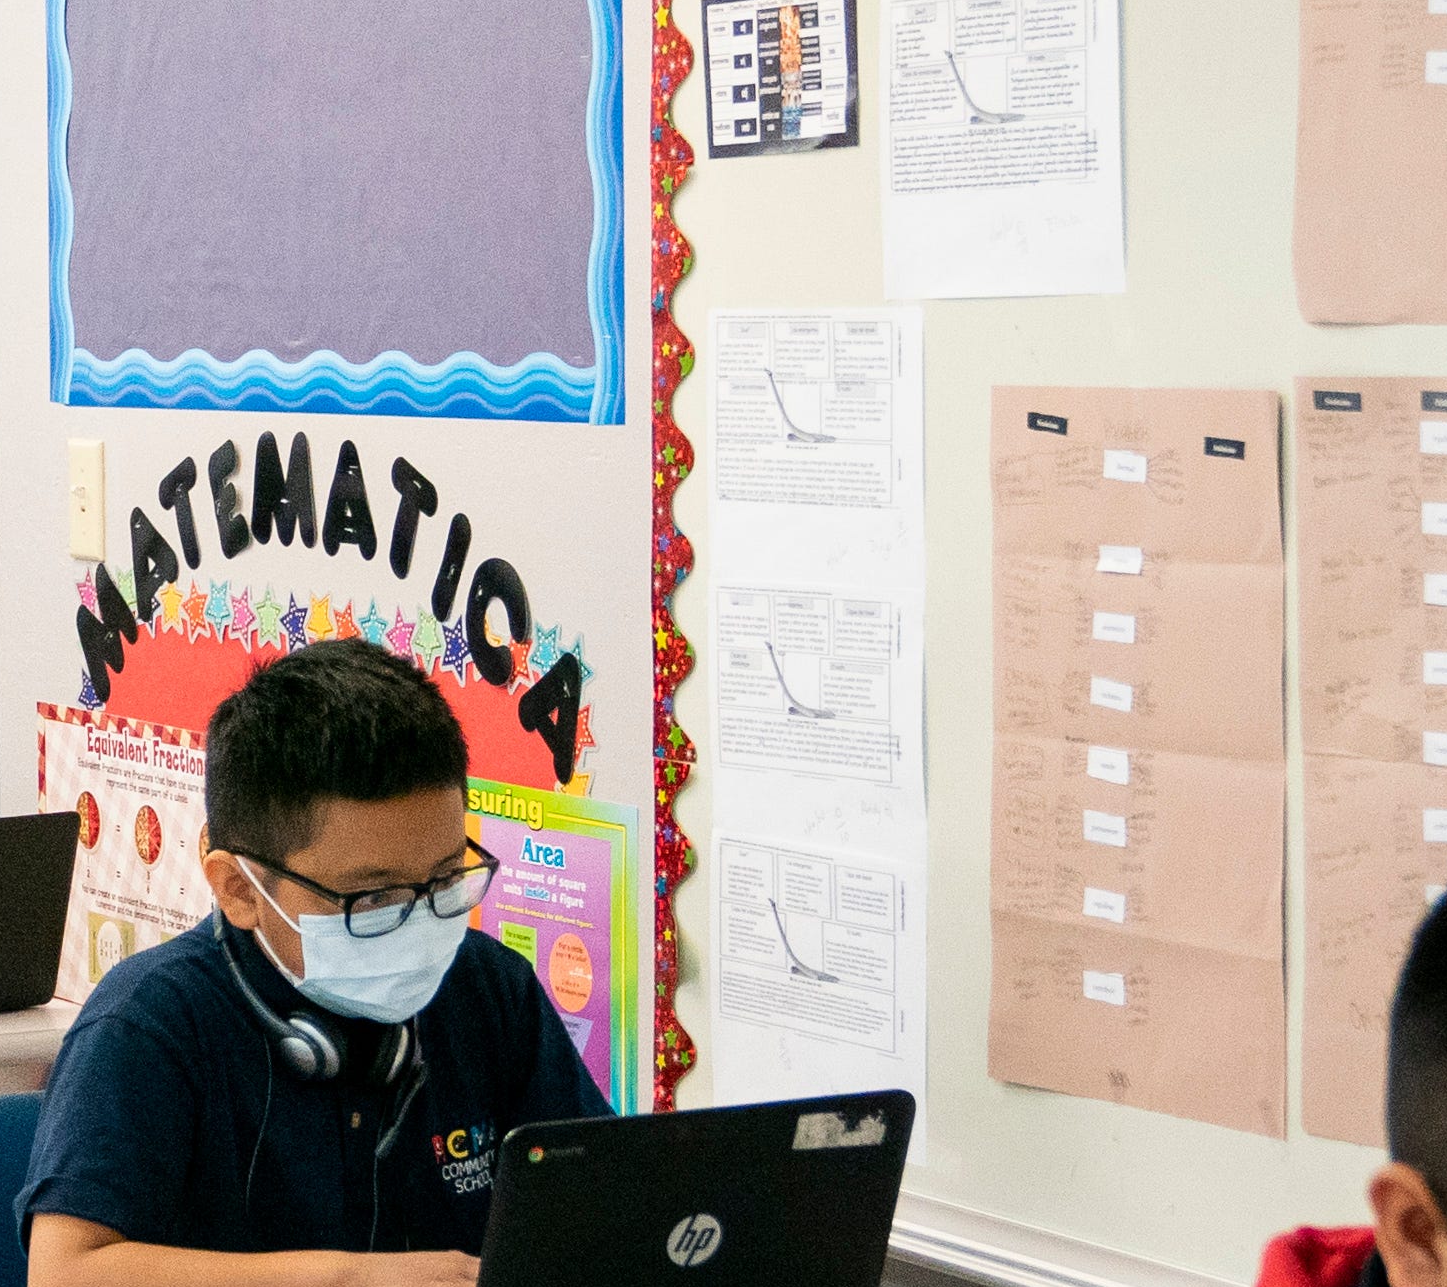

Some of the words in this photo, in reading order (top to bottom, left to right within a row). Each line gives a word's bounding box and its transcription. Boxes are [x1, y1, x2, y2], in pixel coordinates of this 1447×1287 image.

[86, 726, 149, 764] Equivalent
[467, 787, 544, 831] suring
[521, 837, 565, 869] Area
[558, 877, 587, 893] square
[441, 1149, 495, 1181] COMMUNITY
[668, 1214, 723, 1267] hp
